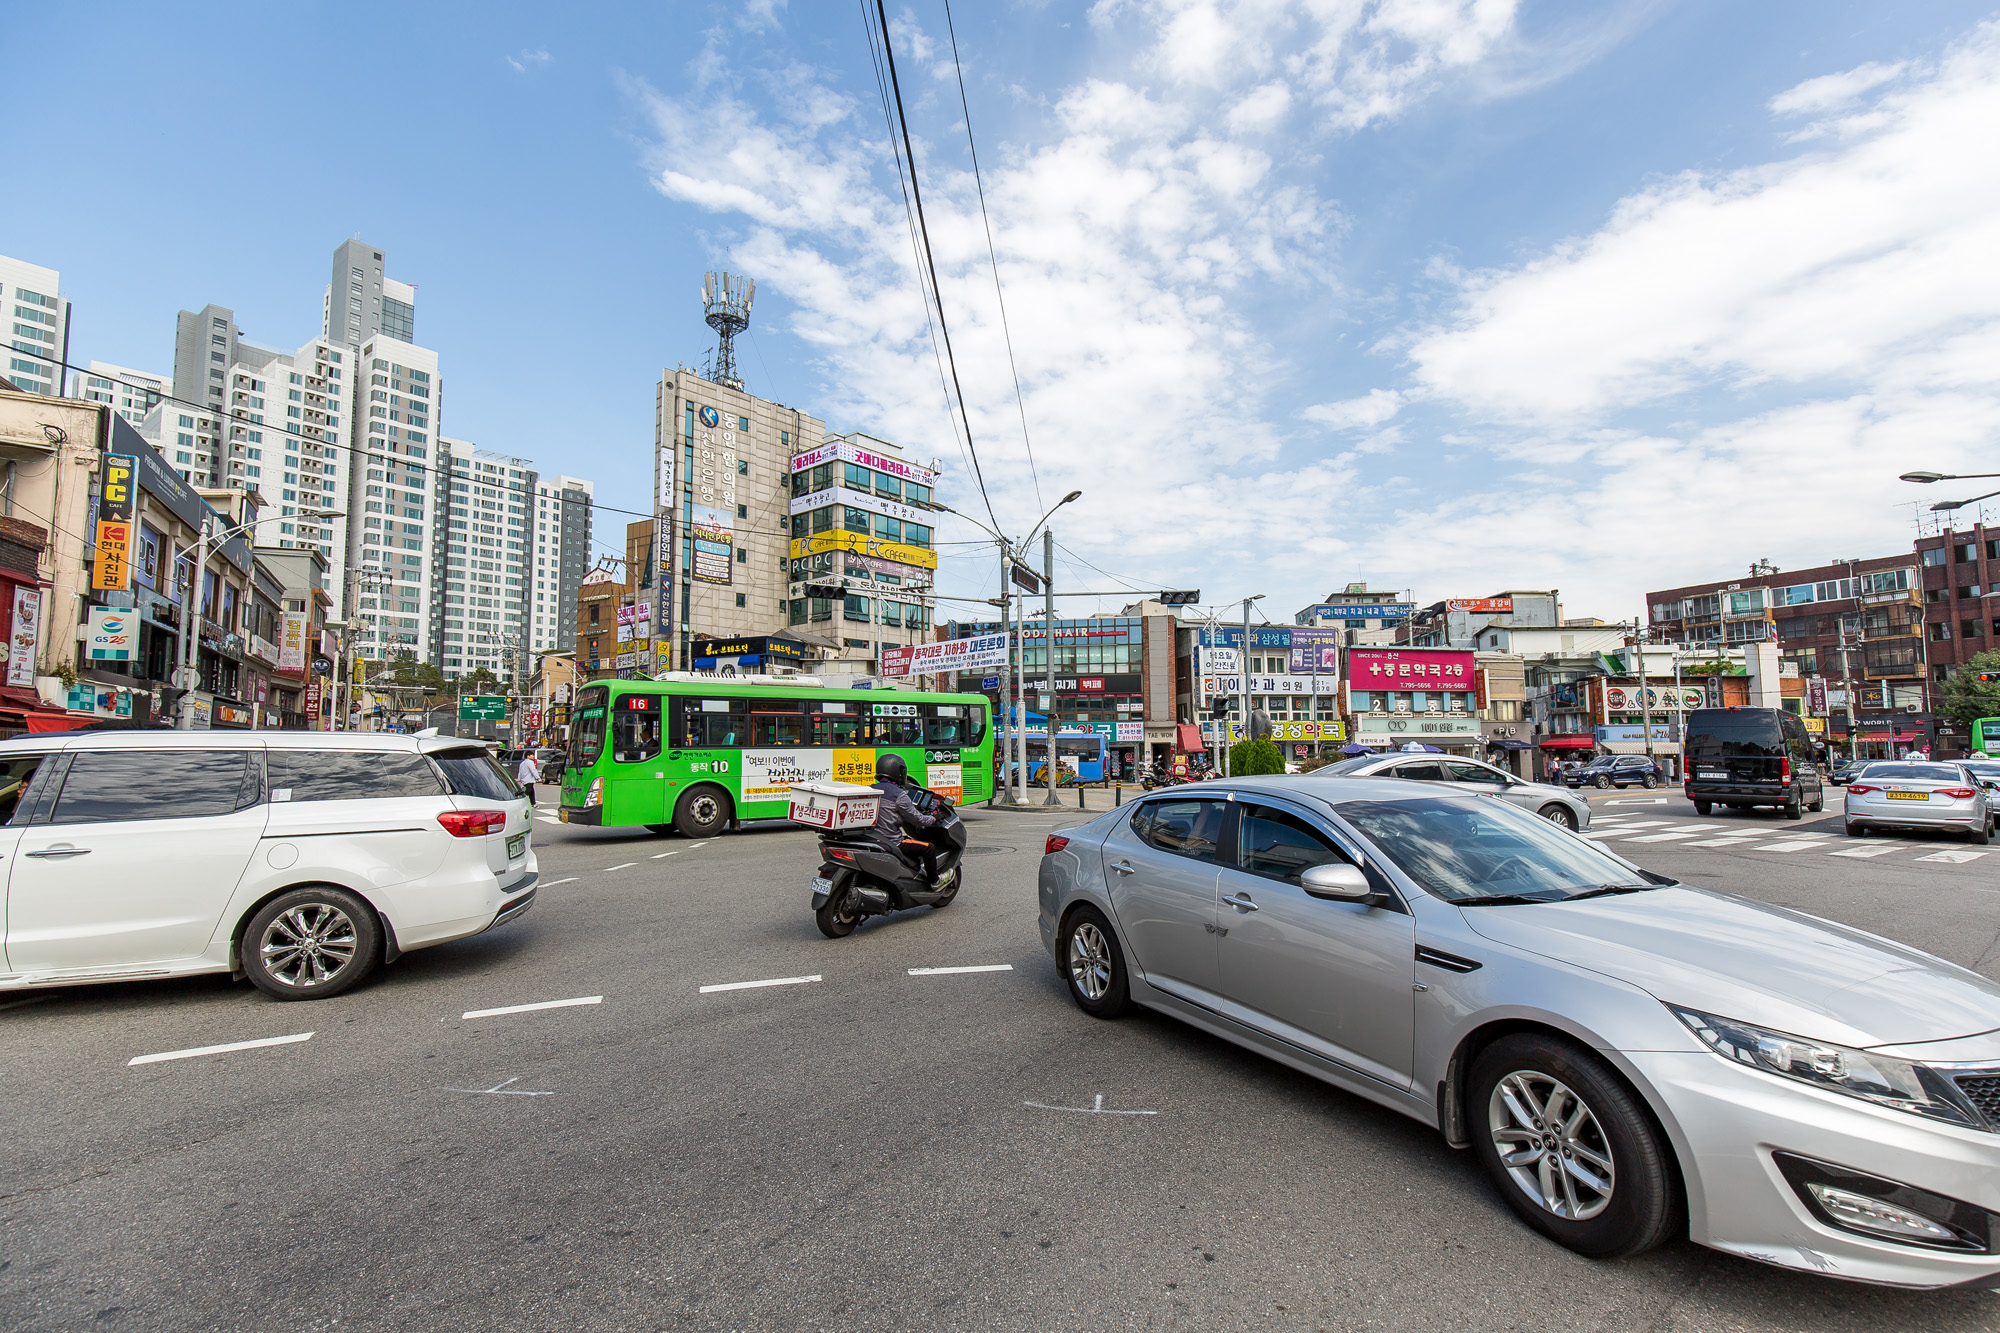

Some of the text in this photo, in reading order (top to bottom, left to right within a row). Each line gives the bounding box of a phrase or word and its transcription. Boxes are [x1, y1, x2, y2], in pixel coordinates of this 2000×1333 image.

[701, 431, 715, 502] 신한은행
[722, 412, 736, 508] 동인한의원
[855, 450, 911, 478] 굿바디필라테스
[105, 467, 129, 502] PC
[911, 472, 932, 486] 817.7942
[101, 540, 125, 551] 현대
[800, 537, 814, 556] PC
[866, 537, 885, 558] PC
[884, 549, 903, 562] CAFE
[103, 552, 120, 587] 사진관
[660, 561, 671, 569] 3F
[661, 592, 669, 626] 신한은행
[95, 635, 128, 645] GS25
[285, 619, 301, 651] 컴퓨터
[1055, 628, 1088, 638] HAIR
[915, 635, 1006, 660] 동작대로 지하화 대토론회
[1383, 663, 1464, 677] 중문약국 2층
[1034, 679, 1077, 691] 부찌개
[1082, 680, 1102, 690] 뷔페
[1282, 681, 1303, 692] 의원
[632, 700, 646, 709] 16
[1373, 699, 1381, 711] 2
[1452, 700, 1462, 711] 문
[1806, 720, 1822, 730] 료기
[1295, 745, 1308, 758] 약
[691, 760, 729, 774] 동작 10
[772, 756, 796, 766] 이번에
[766, 768, 805, 783] 건강검진
[837, 762, 873, 775] 정동병원
[795, 804, 828, 820] 생각대로
[848, 809, 875, 823] 생각대로
